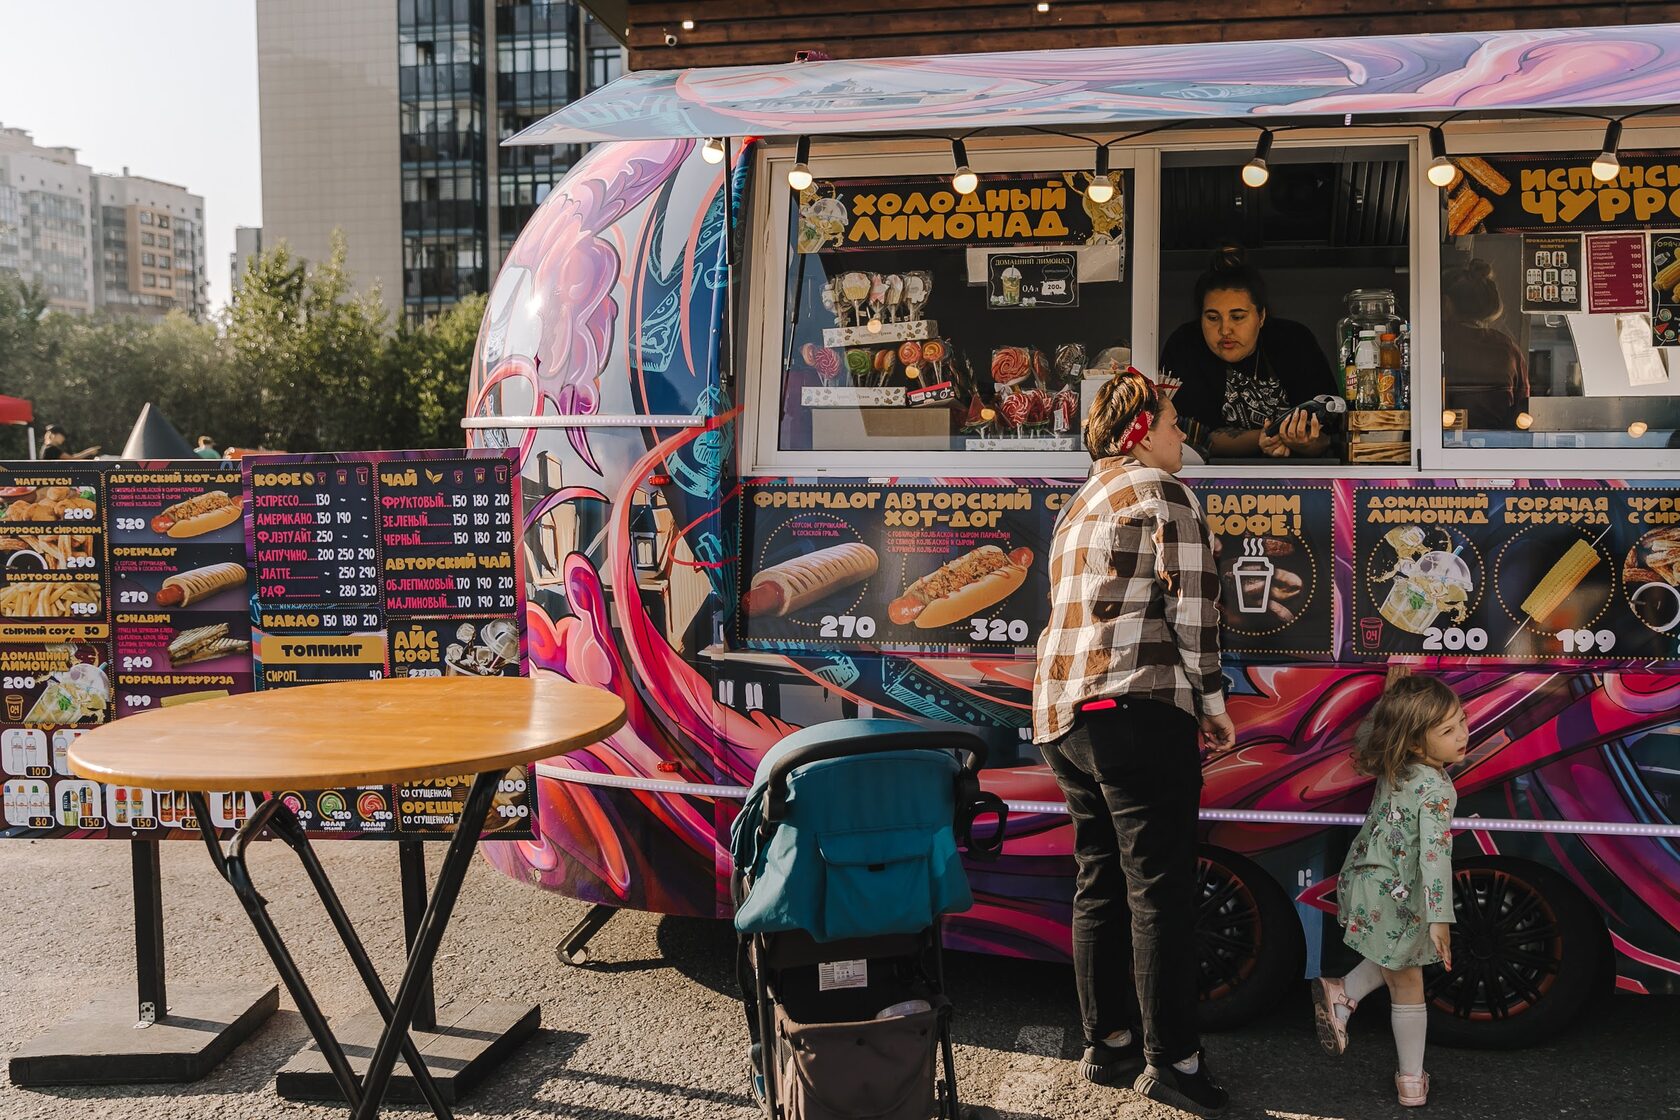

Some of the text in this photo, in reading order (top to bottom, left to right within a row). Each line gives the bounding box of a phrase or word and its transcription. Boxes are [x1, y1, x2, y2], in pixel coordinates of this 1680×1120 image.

[851, 180, 1067, 216] ХОЛОДНЫЙ
[848, 211, 1069, 242] ЛИМОНАД
[15, 477, 72, 485] НАГГЕТСЫ
[109, 472, 241, 483] АВТОРСКИЙ ХОТ-ДОГ
[254, 472, 301, 487] КОФЕ
[380, 468, 418, 487] ЧАЙ
[255, 493, 331, 507] ЭСПРЕССО 130
[381, 492, 510, 509] ФРУКТОВЫЙ 150 180 210
[753, 491, 880, 509] ФРЕНЧДОГ
[884, 488, 1032, 510] АВТОРСКИЙ
[1206, 494, 1301, 514] ВАРИМ
[1367, 493, 1489, 509] ДОМАШНИЙ
[1505, 496, 1609, 512] ГОРЯЧАЯ
[64, 508, 94, 520] 200
[256, 511, 352, 525] АМЕРИКАНО 150 190
[382, 511, 511, 528] ЗЕЛЕНЫЙ 150 180 210
[884, 510, 1003, 528] ХОТ-ДОГ
[1367, 509, 1489, 524] ЛИМОНАД
[1504, 511, 1609, 525] КУКУРУЗА
[1628, 512, 1640, 524] С
[53, 526, 102, 534] СИРОПОМ
[116, 517, 146, 530] 320
[257, 528, 334, 543] ФЛЭТУАЙТ 250
[383, 530, 511, 546] ЧЕРНЫЙ 150 180 210
[113, 547, 177, 557] ФРЕНЧДОГ
[258, 547, 375, 561] КАПУЧИНО 200 250 290
[66, 556, 96, 568] 290
[385, 551, 511, 571] АВТОРСКИЙ ЧАЙ
[6, 573, 99, 581] КАРТОФЕЛЬ ФРИ
[260, 566, 377, 579] ЛАТТЕ 250 290
[385, 574, 513, 591] ОБЛЕПИХОВЫЙ 170 190 210
[120, 591, 149, 603] 270
[260, 584, 378, 598] РАФ 280 320
[387, 593, 515, 609] МАЛИНОВЫЙ 170 190 210
[70, 602, 98, 615] 150
[116, 614, 171, 623] СЭНДВИЧ
[262, 613, 378, 628] КАКАО 150 180 210
[3, 626, 100, 635] СЫРНЫЙ СОУС 50
[819, 616, 876, 638] 270
[969, 618, 1029, 642] 320
[394, 624, 439, 649] АЙС
[1422, 627, 1488, 651] 200
[1555, 628, 1616, 653] 199
[0, 649, 70, 661] ДОМАШНИЙ
[281, 644, 363, 657] ТОППИНГ
[394, 649, 440, 663] КОФЕ
[0, 660, 70, 672] ЛИМОНАД
[122, 656, 153, 668] 240
[3, 676, 36, 689] 200
[118, 675, 234, 685] ГОРЯЧАЯ КУКУРУЗА
[266, 670, 383, 682] СИРОП 40
[125, 694, 151, 707] 199
[31, 767, 47, 776] 100
[498, 779, 527, 792] 100
[400, 787, 452, 798] СО СГУЩЕНКОЙ
[331, 810, 352, 820] 120
[372, 810, 393, 820] 150
[401, 801, 529, 818] ОРЕШК 100
[35, 817, 48, 826] 80
[84, 818, 100, 827] 150
[136, 818, 152, 827] 150
[185, 818, 200, 828] 20
[402, 814, 455, 824] СО СГУЩЕНКОЙ
